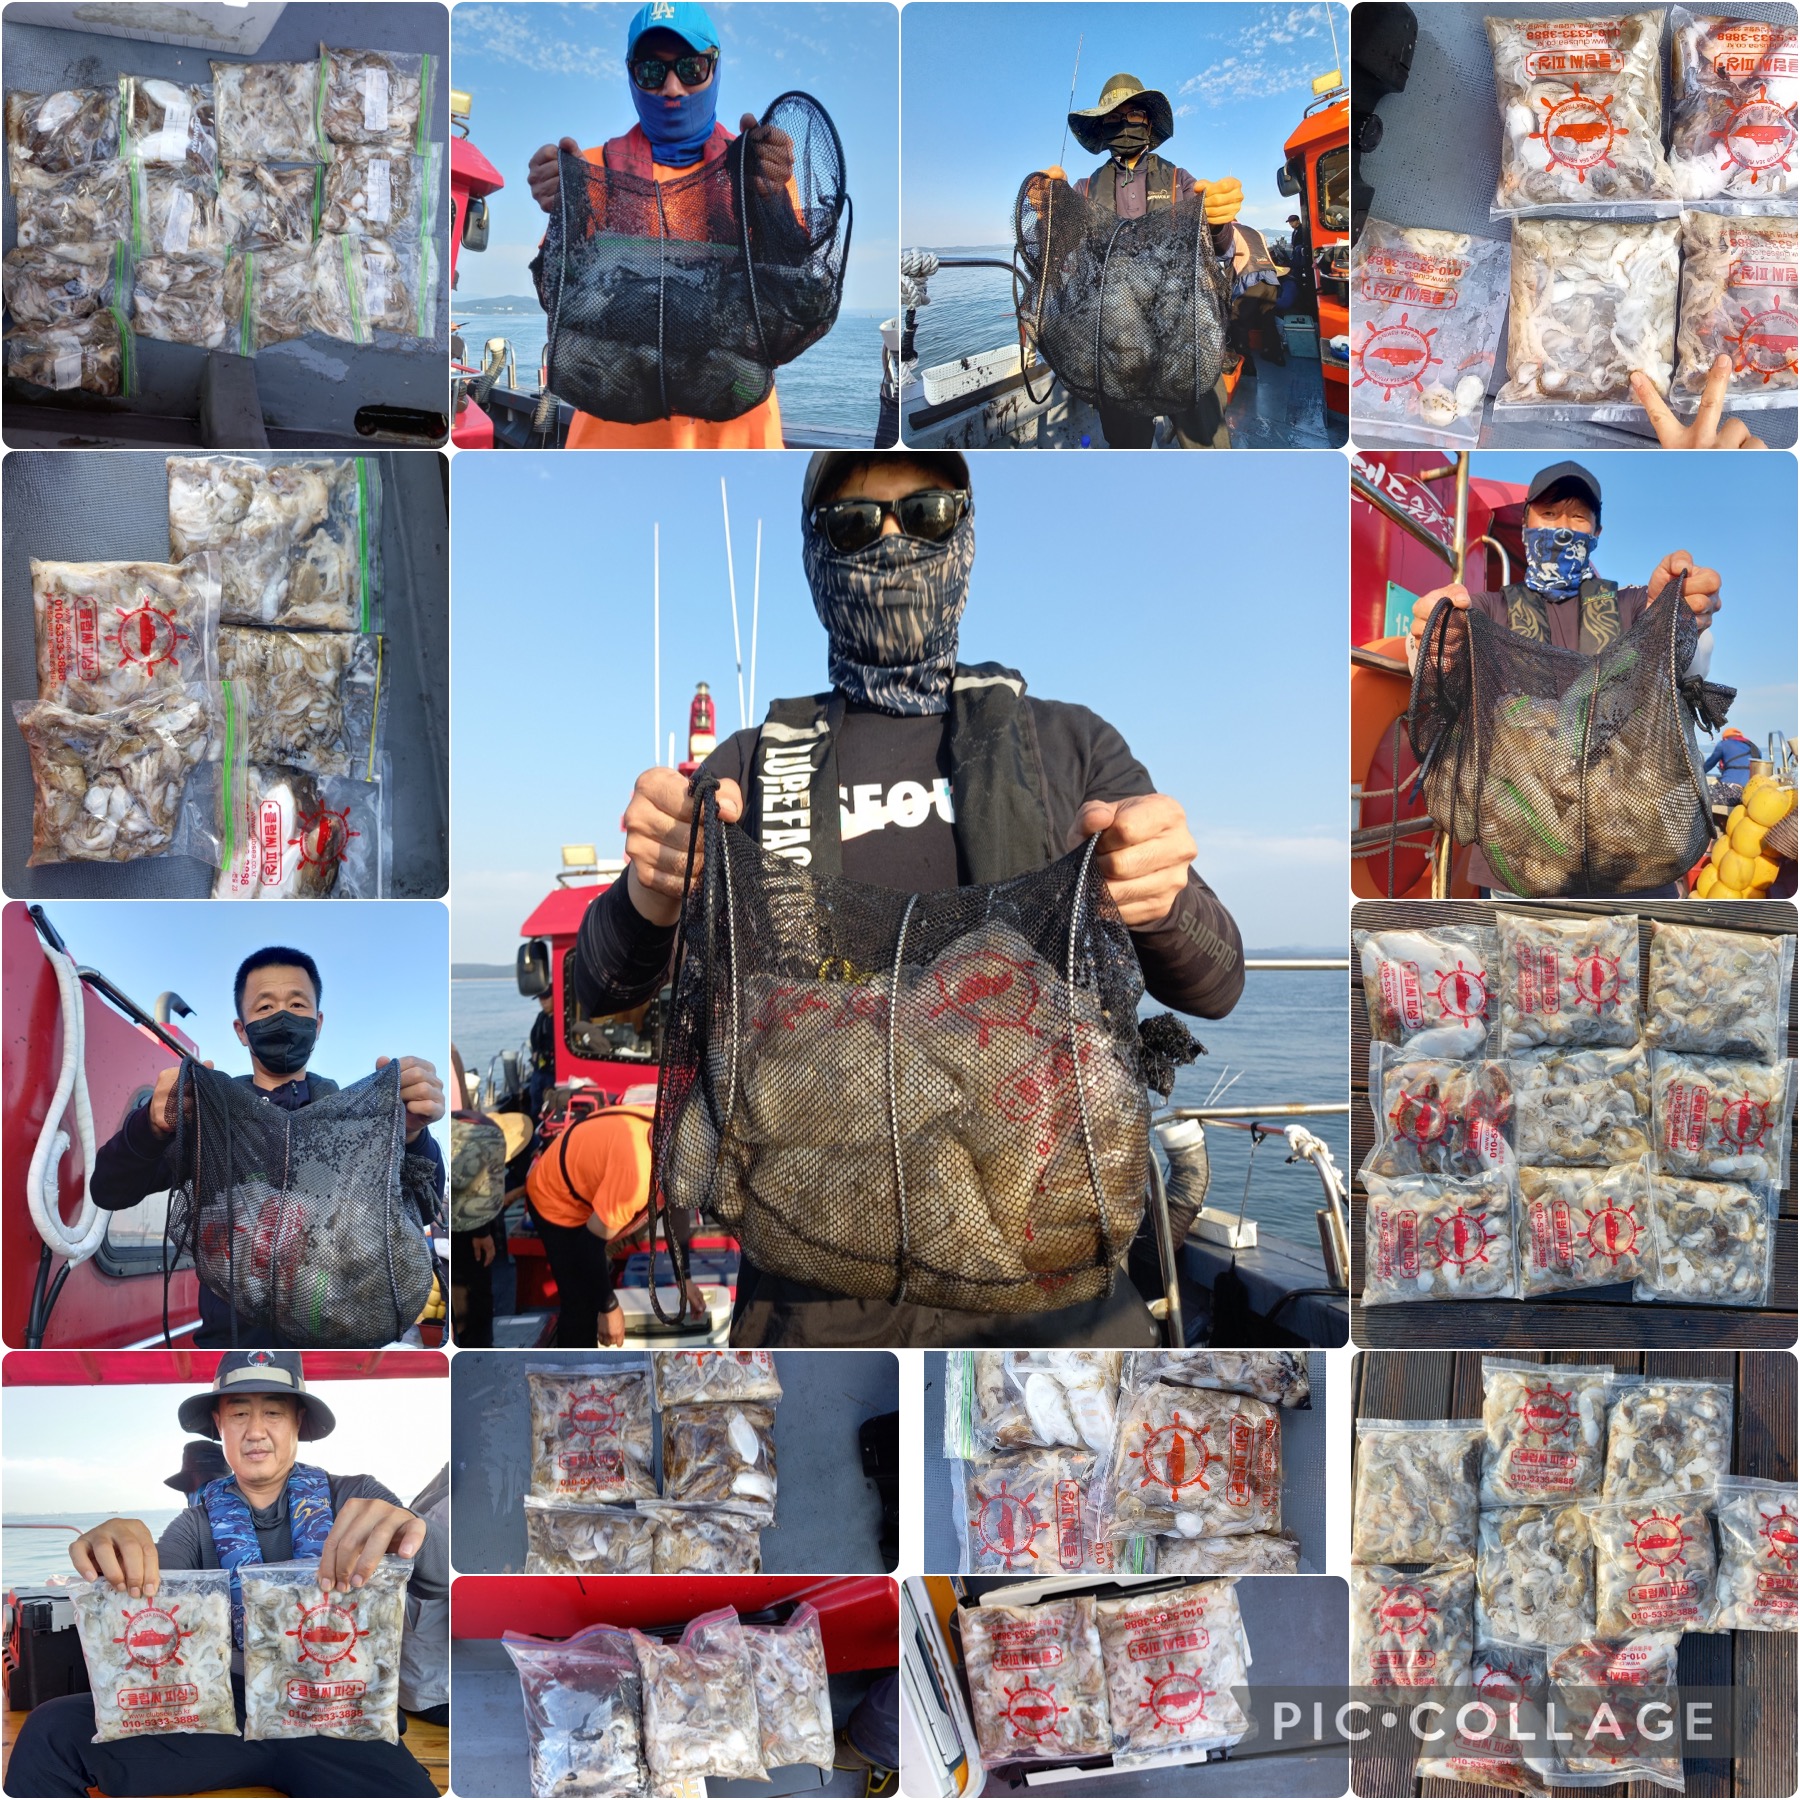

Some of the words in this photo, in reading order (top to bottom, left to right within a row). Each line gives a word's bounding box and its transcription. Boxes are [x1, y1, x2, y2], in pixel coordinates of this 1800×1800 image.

[1526, 29, 1620, 40] 010-5333-3888
[1538, 55, 1566, 70] 피싱
[1569, 54, 1612, 68] 클럽씨
[1726, 57, 1754, 72] 피싱
[1368, 256, 1462, 276] 010-5333-3888
[1742, 266, 1768, 280] 피싱
[1374, 283, 1402, 298] 피싱
[1405, 287, 1445, 304] 클럽씨
[80, 608, 94, 644] 클럽씨
[81, 648, 94, 670] 피싱
[264, 812, 277, 848] 클럽씨
[264, 852, 278, 876] 피싱
[1179, 910, 1237, 972] SHIMANO
[1544, 956, 1555, 984] 클럽씨
[1407, 1000, 1419, 1020] 피싱
[1694, 1096, 1704, 1122] 클럽씨
[1556, 1211, 1568, 1238] 클럽씨
[1402, 1220, 1414, 1248] 클럽씨
[1559, 1242, 1570, 1260] 피싱
[1404, 1252, 1414, 1270] 피싱
[1236, 1426, 1250, 1452] 피싱
[1520, 1452, 1548, 1464] 클럽씨
[1550, 1454, 1568, 1466] 피싱
[1232, 1456, 1246, 1494] 클럽씨
[1061, 1491, 1074, 1514] 피싱
[1062, 1518, 1078, 1557] 클럽씨
[1638, 1587, 1668, 1600] 클럽씨
[1670, 1584, 1689, 1596] 피싱
[1124, 1608, 1204, 1630] 010-5333-3888
[1632, 1607, 1698, 1620] 010-5333-3888
[1138, 1642, 1161, 1655] 피싱
[1163, 1633, 1198, 1651] 클럽씨
[1001, 1654, 1020, 1666] 피싱
[1022, 1650, 1052, 1665] 클럽씨
[128, 1692, 162, 1706] 클럽씨
[164, 1689, 188, 1702] 피싱
[298, 1684, 331, 1698] 클럽씨
[334, 1684, 356, 1696] 피싱
[122, 1714, 200, 1728] 010-5333-3888
[288, 1709, 363, 1722] 010-5333-3888
[1494, 1742, 1514, 1754] 피싱
